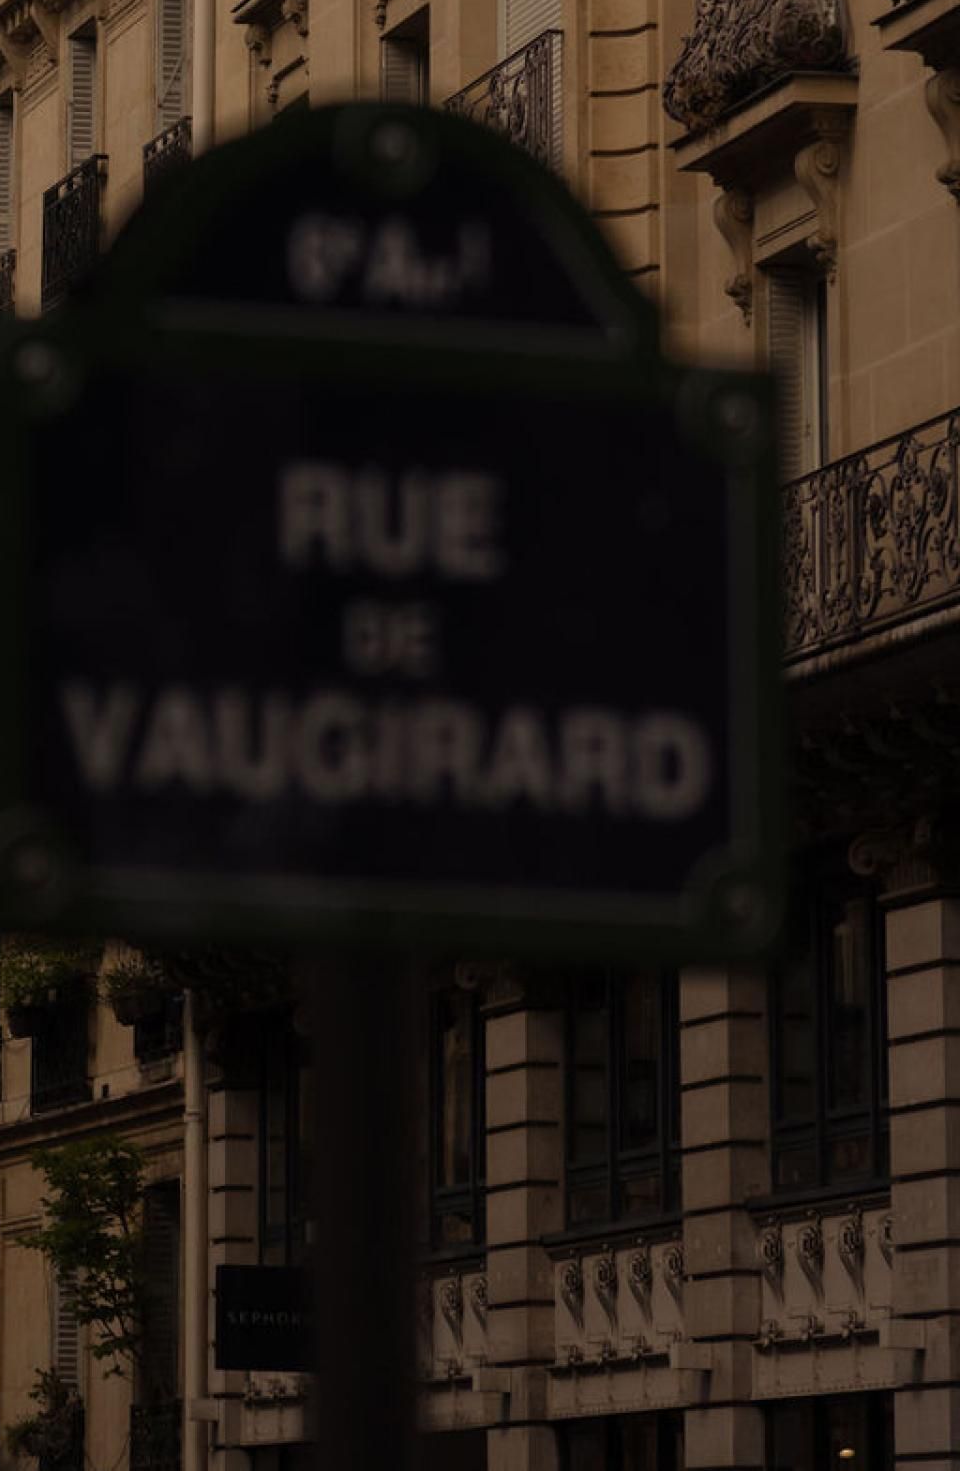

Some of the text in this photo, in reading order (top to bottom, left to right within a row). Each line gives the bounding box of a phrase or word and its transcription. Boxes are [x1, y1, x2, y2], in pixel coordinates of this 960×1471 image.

[279, 462, 506, 581] RUE
[342, 600, 438, 677] DE
[58, 682, 711, 821] VAUGIRARD
[225, 1310, 302, 1326] SEPHOR
